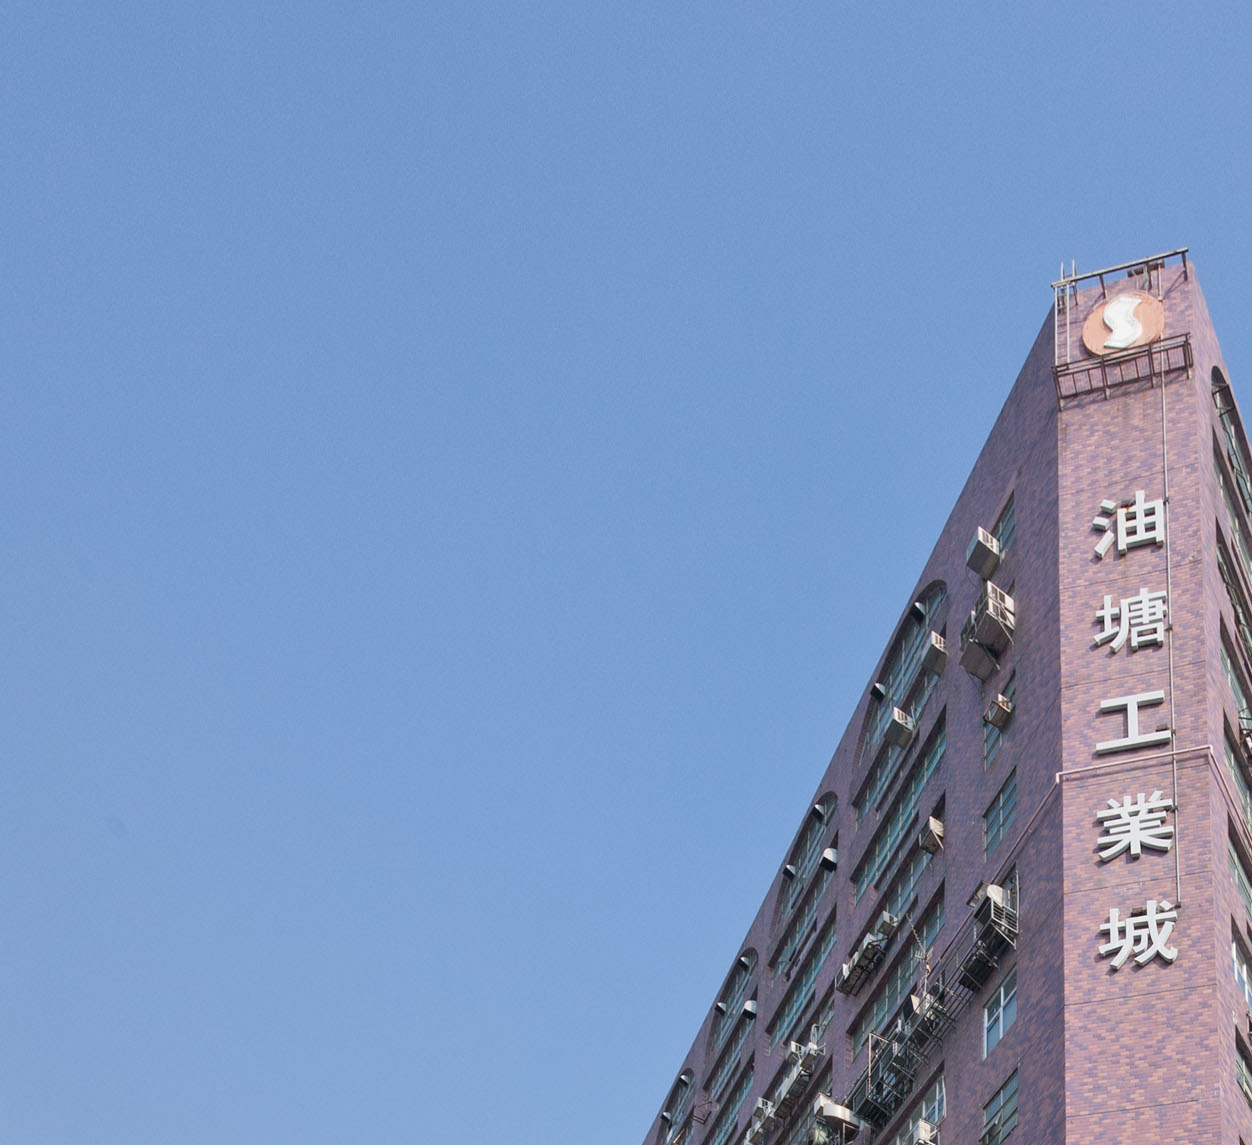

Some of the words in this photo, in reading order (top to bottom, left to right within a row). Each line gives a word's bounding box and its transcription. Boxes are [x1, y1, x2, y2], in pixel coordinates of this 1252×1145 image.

[1091, 489, 1179, 971] 油塘工業城
